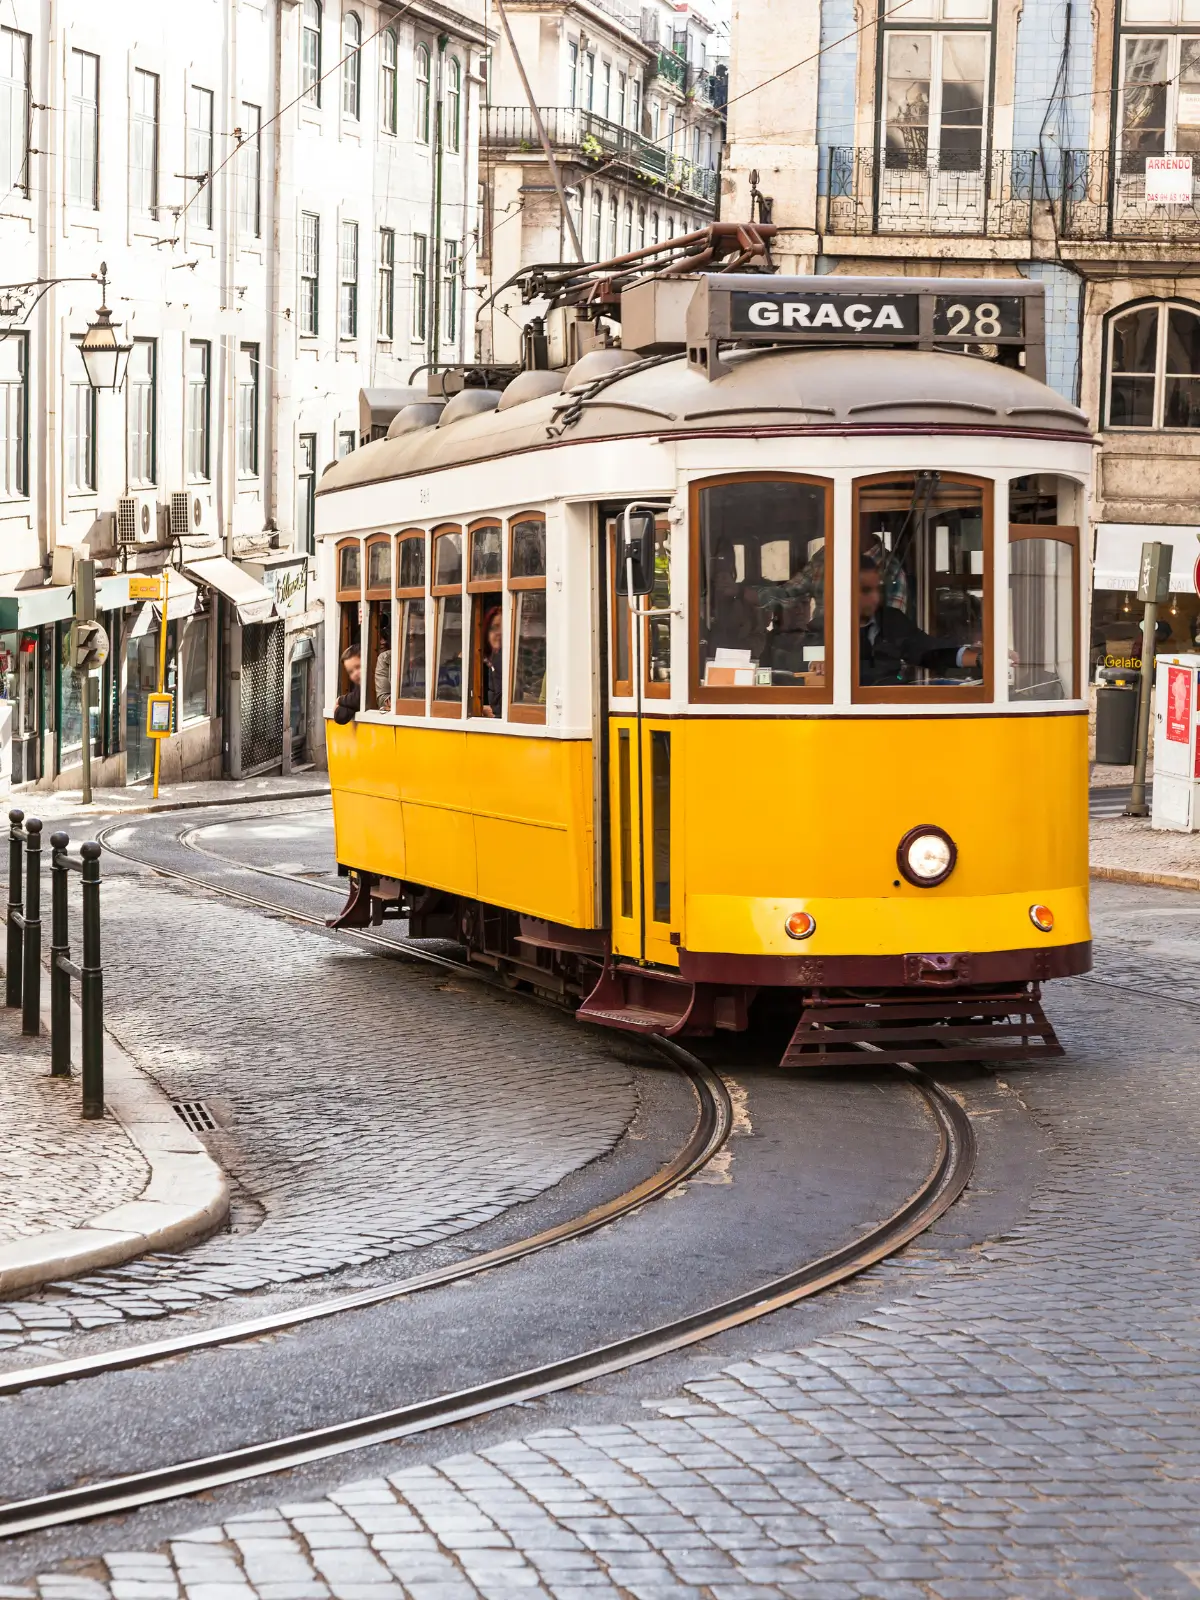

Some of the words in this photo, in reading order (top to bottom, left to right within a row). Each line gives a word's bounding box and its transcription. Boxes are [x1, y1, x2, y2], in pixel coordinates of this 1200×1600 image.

[1148, 159, 1190, 169] ARRENDO
[1147, 193, 1158, 201] DAS
[1180, 193, 1190, 201] 12H
[748, 302, 904, 332] GRAÇA
[946, 303, 1002, 337] 28
[1105, 654, 1142, 668] Gelato
